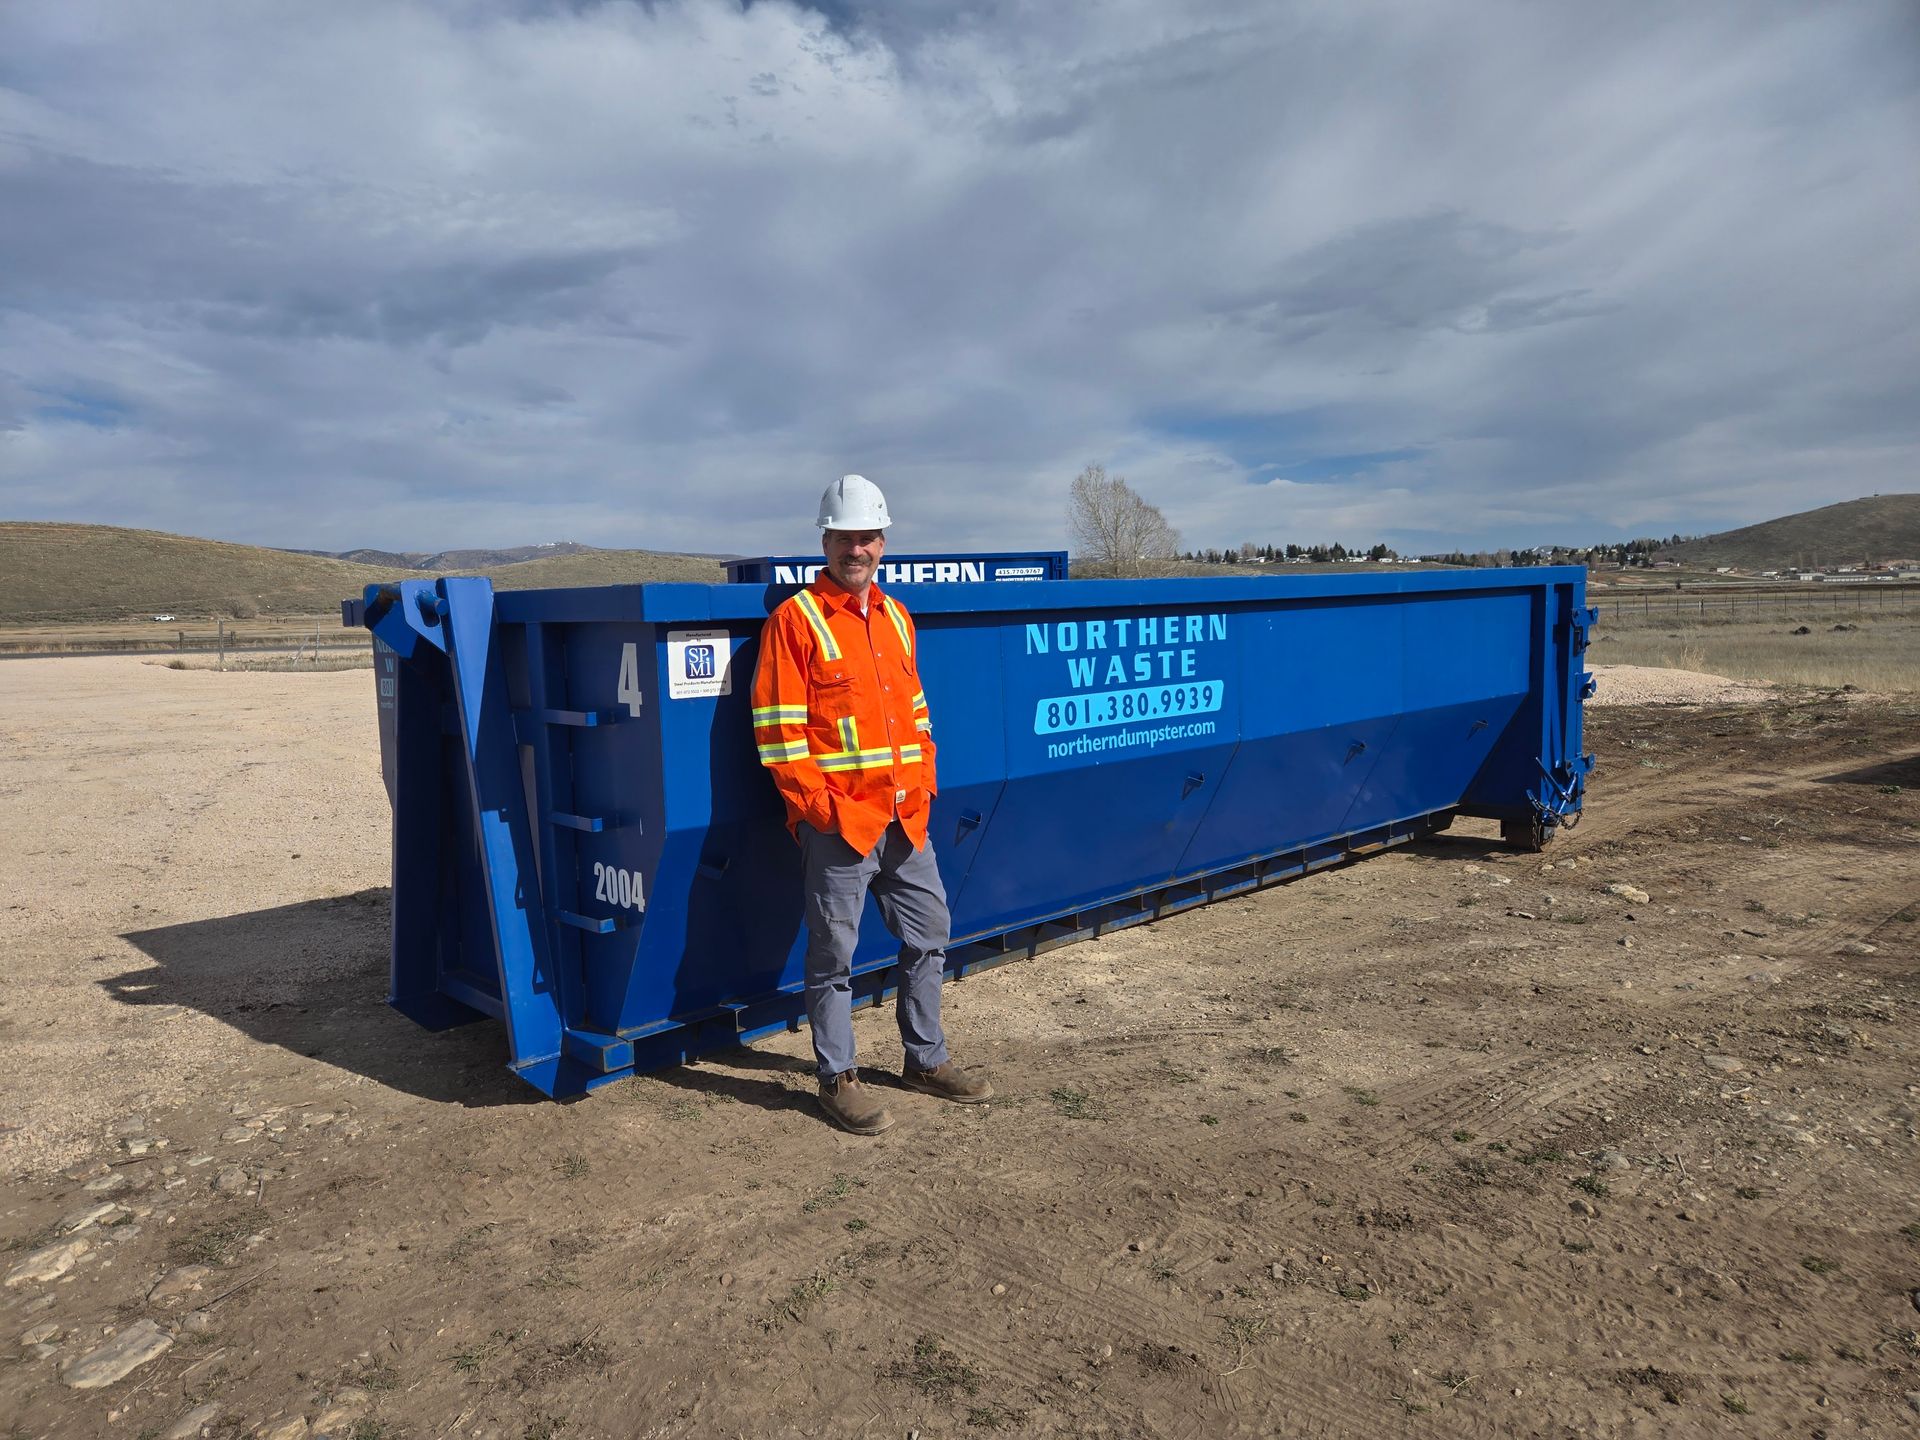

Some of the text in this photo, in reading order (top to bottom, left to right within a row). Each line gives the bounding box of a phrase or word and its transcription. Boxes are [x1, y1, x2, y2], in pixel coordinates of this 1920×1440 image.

[774, 562, 985, 584] NOTHERN
[1026, 614, 1227, 654] NORTHERN
[618, 643, 642, 717] 4
[1067, 649, 1196, 688] WASTE
[1047, 685, 1213, 728] 801.380.9939
[1048, 721, 1216, 758] northerndumpster.com
[594, 862, 646, 912] 2004
